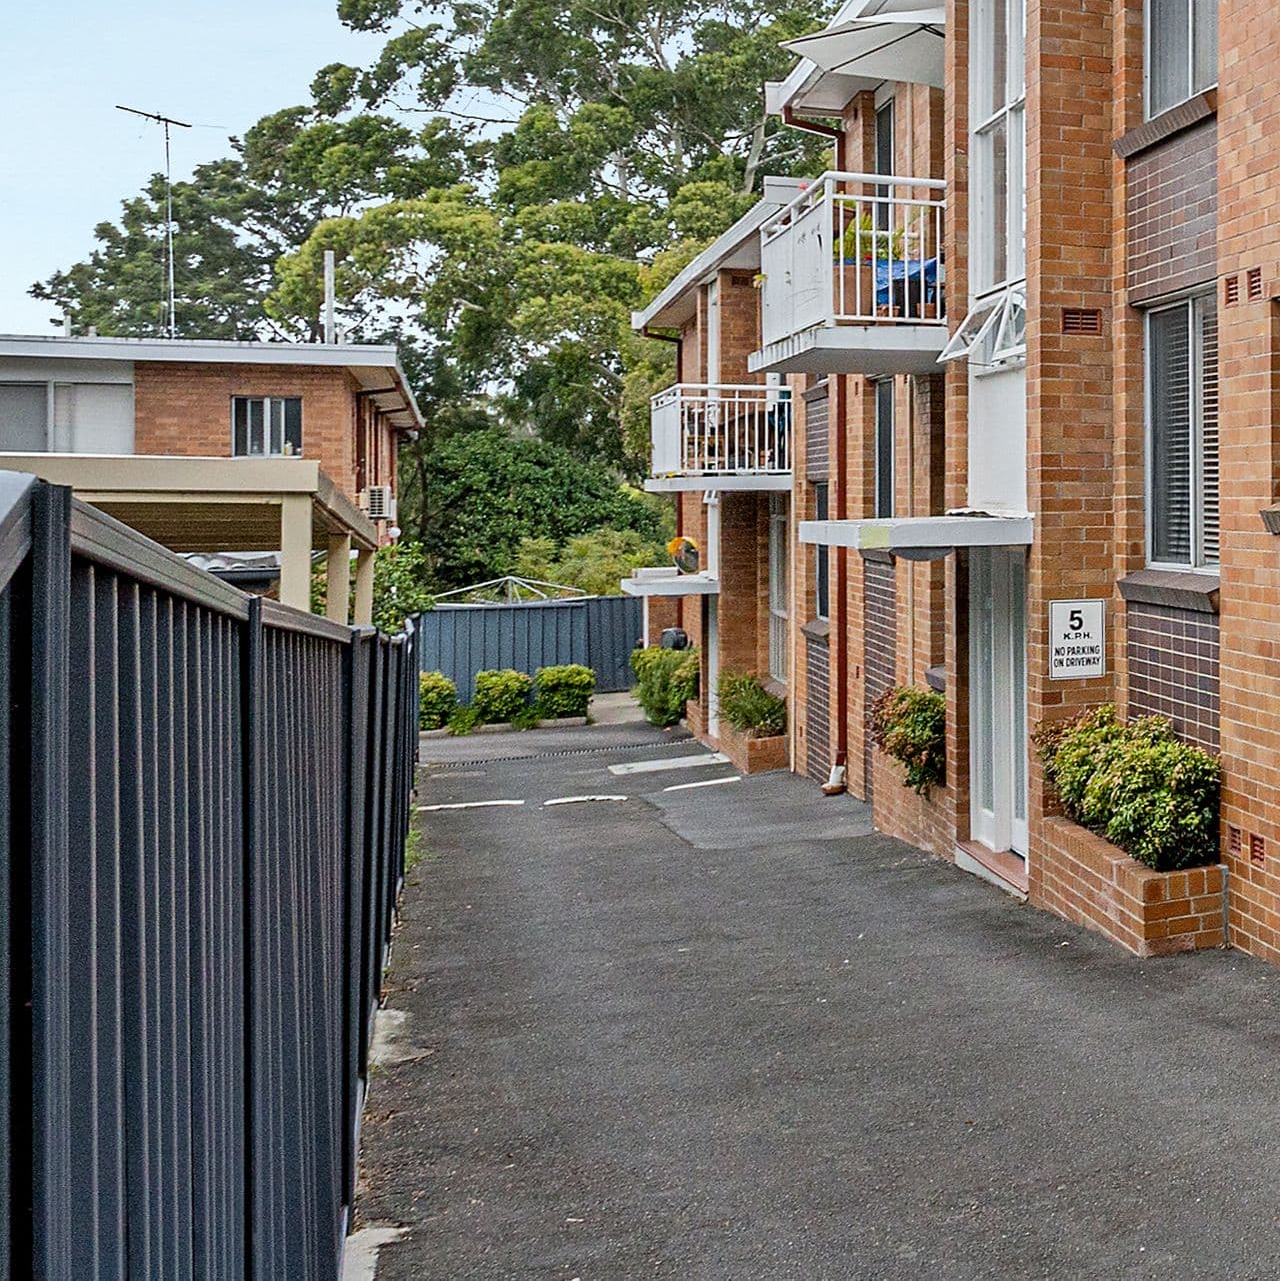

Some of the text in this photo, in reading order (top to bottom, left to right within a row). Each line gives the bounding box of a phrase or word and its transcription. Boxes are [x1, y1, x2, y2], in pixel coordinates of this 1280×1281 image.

[1069, 610, 1083, 631] 5
[1054, 645, 1100, 656] NO PARKING
[1053, 656, 1101, 668] ON DRIVEWAY
